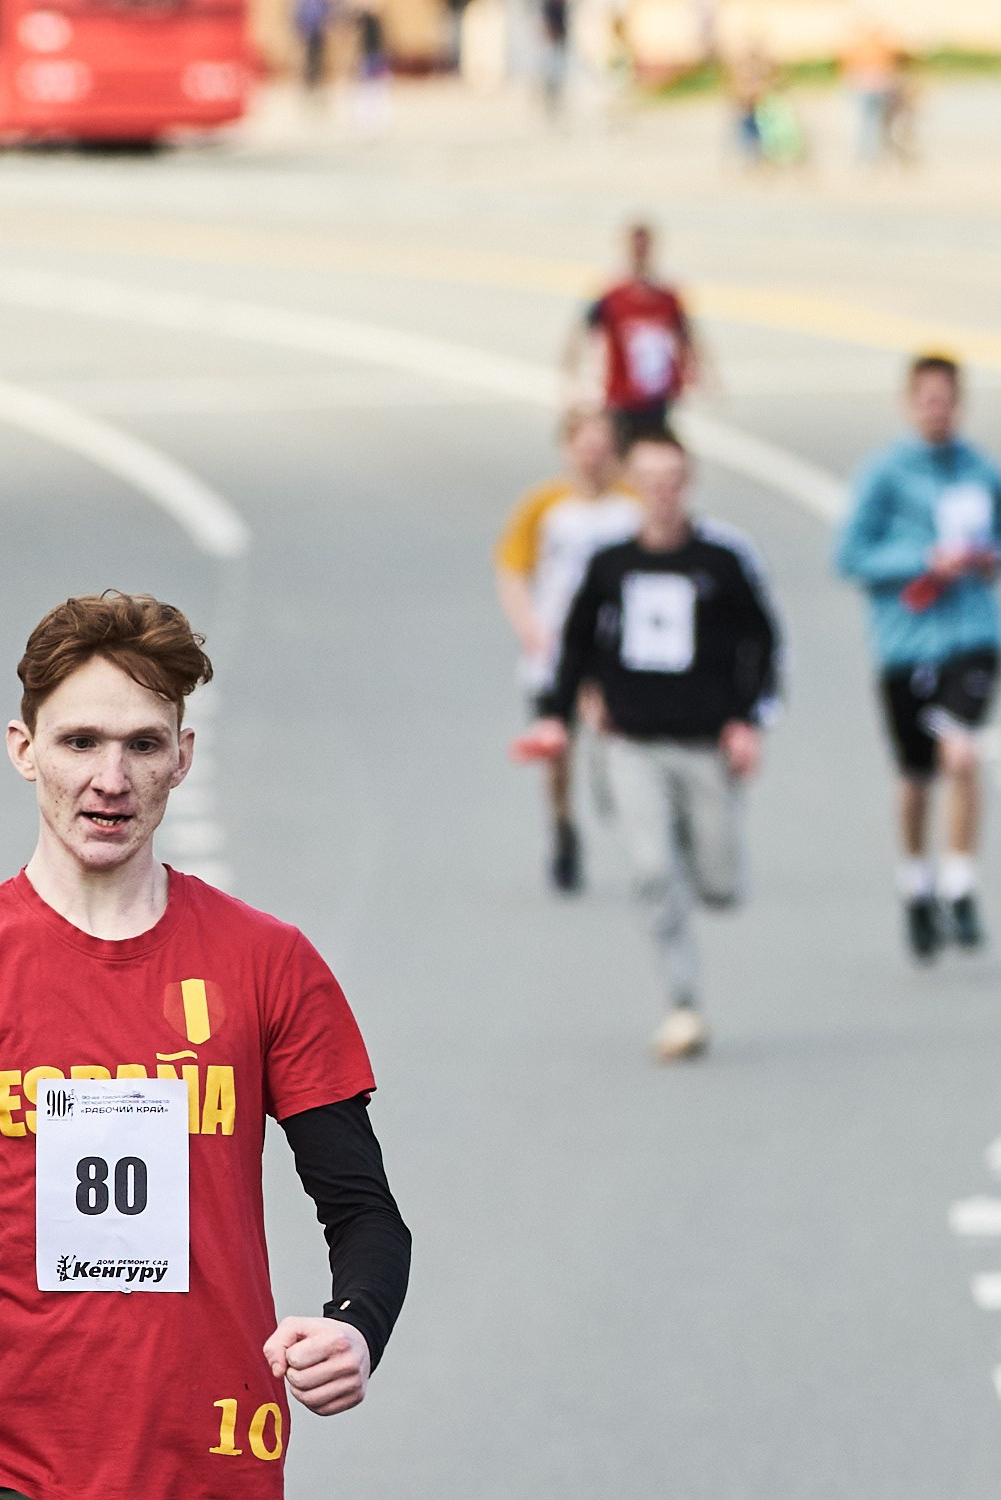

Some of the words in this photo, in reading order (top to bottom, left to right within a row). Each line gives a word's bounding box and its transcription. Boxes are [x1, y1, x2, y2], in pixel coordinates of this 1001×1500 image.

[75, 1156, 148, 1216] 80
[73, 1261, 168, 1283] Кенгуру
[209, 1398, 283, 1461] 10
